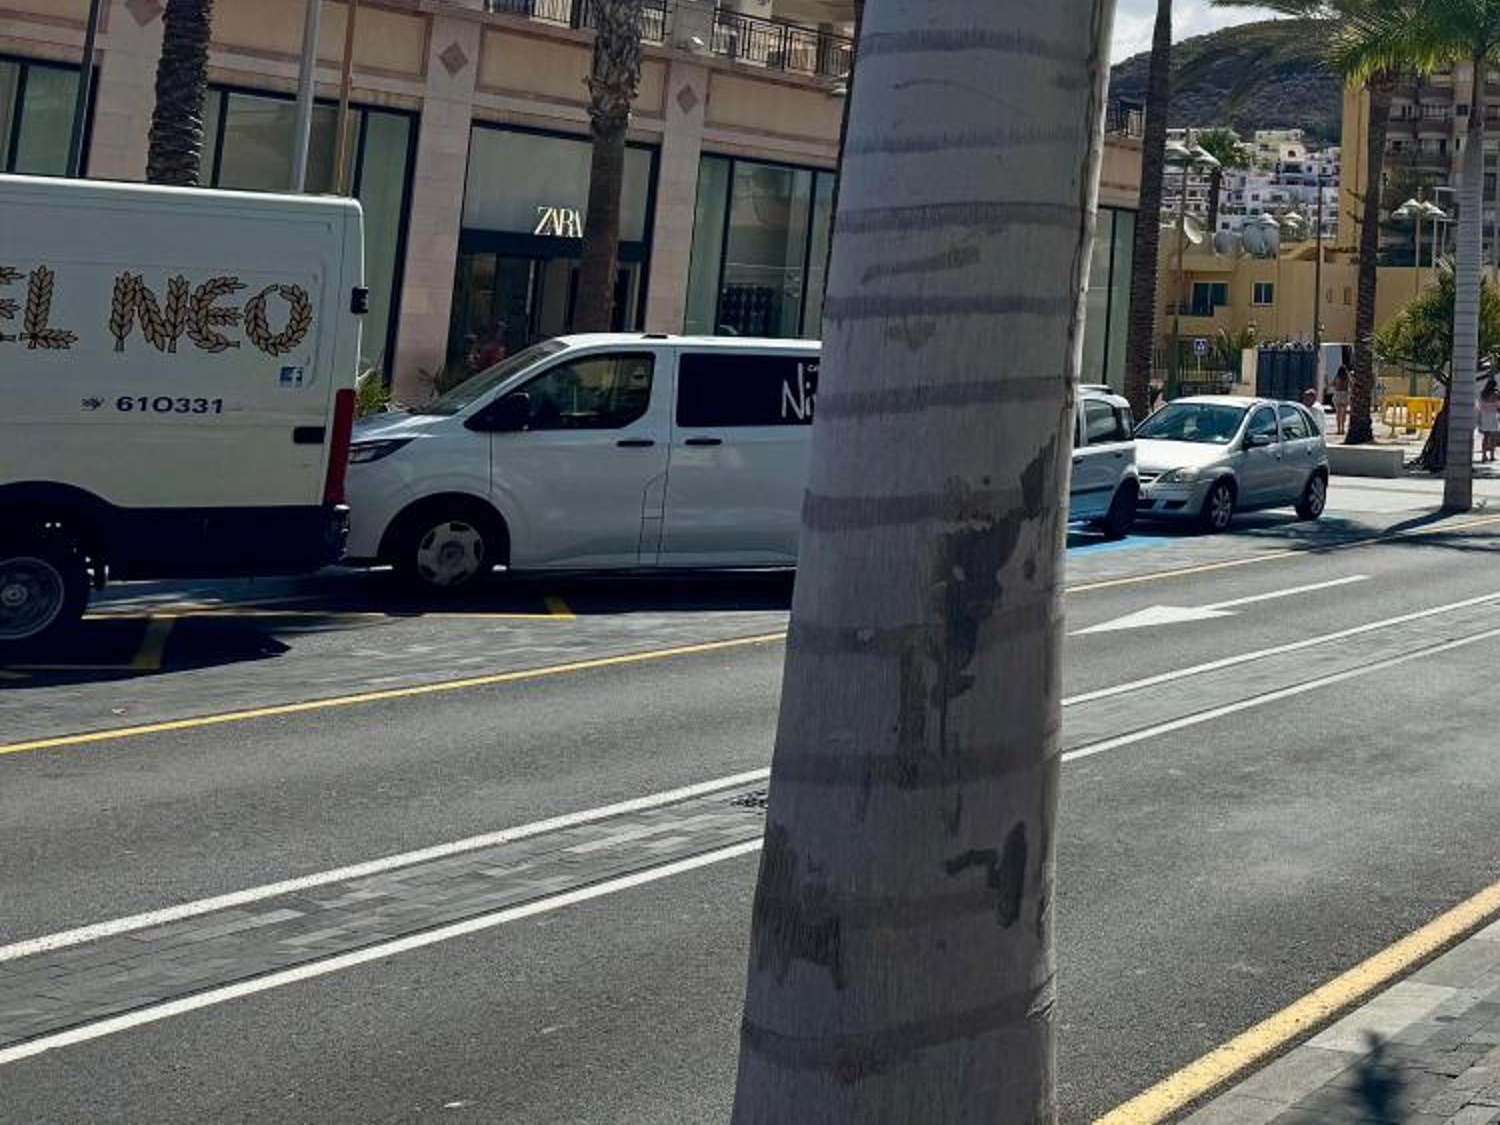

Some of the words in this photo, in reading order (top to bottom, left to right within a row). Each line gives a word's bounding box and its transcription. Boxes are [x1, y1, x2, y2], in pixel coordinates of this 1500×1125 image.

[534, 206, 583, 238] ZARA
[109, 271, 313, 357] NEO
[116, 396, 224, 414] 610331
